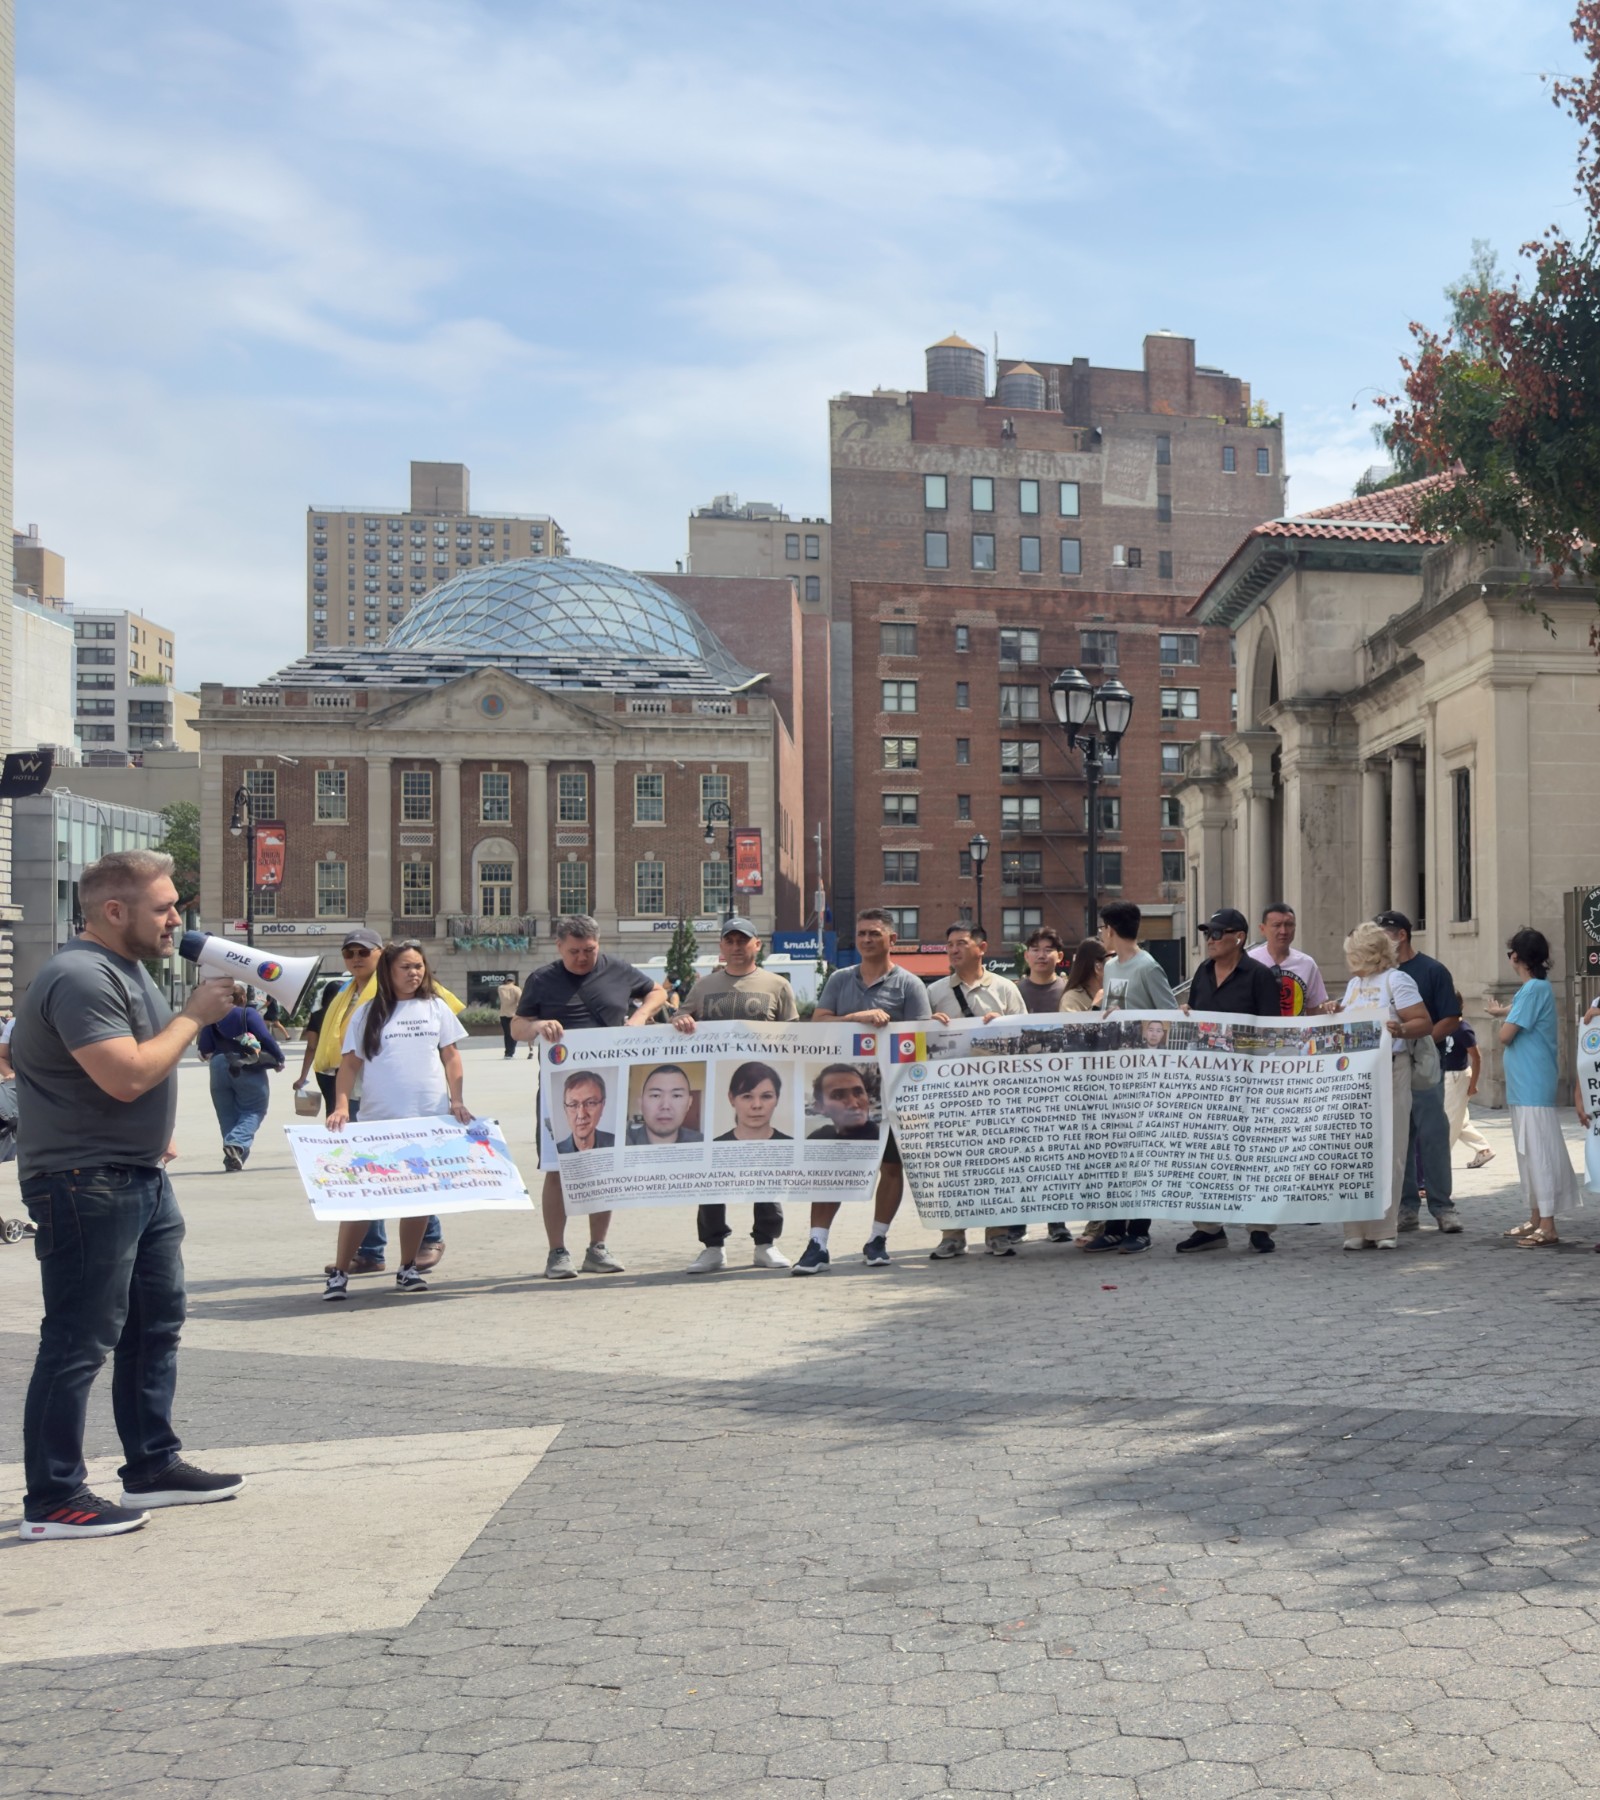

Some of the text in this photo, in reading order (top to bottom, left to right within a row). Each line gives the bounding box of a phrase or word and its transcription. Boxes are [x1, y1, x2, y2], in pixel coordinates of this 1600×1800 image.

[18, 758, 43, 773] W
[262, 923, 296, 935] petco
[226, 950, 252, 966] PYLE
[481, 974, 506, 982] petco
[572, 1042, 842, 1061] CONGRESS OF THE OIRAT-KALMYK PEOPLE
[937, 1053, 1326, 1078] CONGRESS OF THE OIRAT-KALMYK PEOPLE
[902, 1085, 918, 1093] THE
[921, 1082, 951, 1092] ETHNIC
[954, 1079, 989, 1089] KALMYK
[993, 1075, 1060, 1087] ORGANIZATION
[1063, 1074, 1082, 1082] WAS
[1086, 1073, 1123, 1082] FOUNDED
[1151, 1072, 1160, 1080] IN
[1164, 1073, 1191, 1082] ELISTA,
[1196, 1073, 1231, 1083] RUSSIA'S
[1234, 1076, 1285, 1086] SOUTHWEST
[1287, 1078, 1314, 1086] ETHNIC
[1358, 1072, 1372, 1080] THE
[895, 1094, 920, 1104] MOST
[922, 1090, 970, 1101] DEPRESSED
[972, 1089, 990, 1098] AND
[993, 1087, 1020, 1097] POOR
[1023, 1084, 1070, 1094] ECONOMIC
[1073, 1083, 1108, 1092] REGION,
[1110, 1082, 1121, 1091] TO
[1159, 1082, 1197, 1091] KALMYKS
[1199, 1083, 1218, 1092] AND
[1220, 1084, 1245, 1094] FIGHT
[1246, 1086, 1263, 1095] FOR
[1265, 1087, 1285, 1095] OUR
[1287, 1087, 1313, 1095] RIGHTS
[1316, 1085, 1330, 1094] AND
[298, 1135, 348, 1145] Russian
[351, 1131, 428, 1144] Colonialism
[430, 1127, 462, 1136] Must
[323, 1155, 474, 1179] Captive Nations
[312, 1176, 364, 1189] Against
[367, 1172, 425, 1185] Colonial
[596, 1176, 633, 1187] BALTYKOV
[634, 1174, 667, 1183] EDUARD,
[669, 1172, 707, 1180] OCHIROV
[708, 1170, 736, 1179] ALTAN,
[739, 1170, 775, 1178] EGEREVA
[776, 1170, 806, 1178] DARIYA,
[834, 1170, 866, 1178] EVGENIY,
[624, 1185, 645, 1193] WHO
[646, 1184, 667, 1192] WERE
[668, 1182, 693, 1191] JAILED
[694, 1181, 713, 1189] AND
[714, 1180, 755, 1188] TORTURED
[756, 1179, 765, 1187] IN
[767, 1179, 782, 1187] THE
[783, 1179, 812, 1187] TOUGH
[813, 1179, 844, 1187] RUSSIAN
[326, 1179, 502, 1199] For Political Freedom
